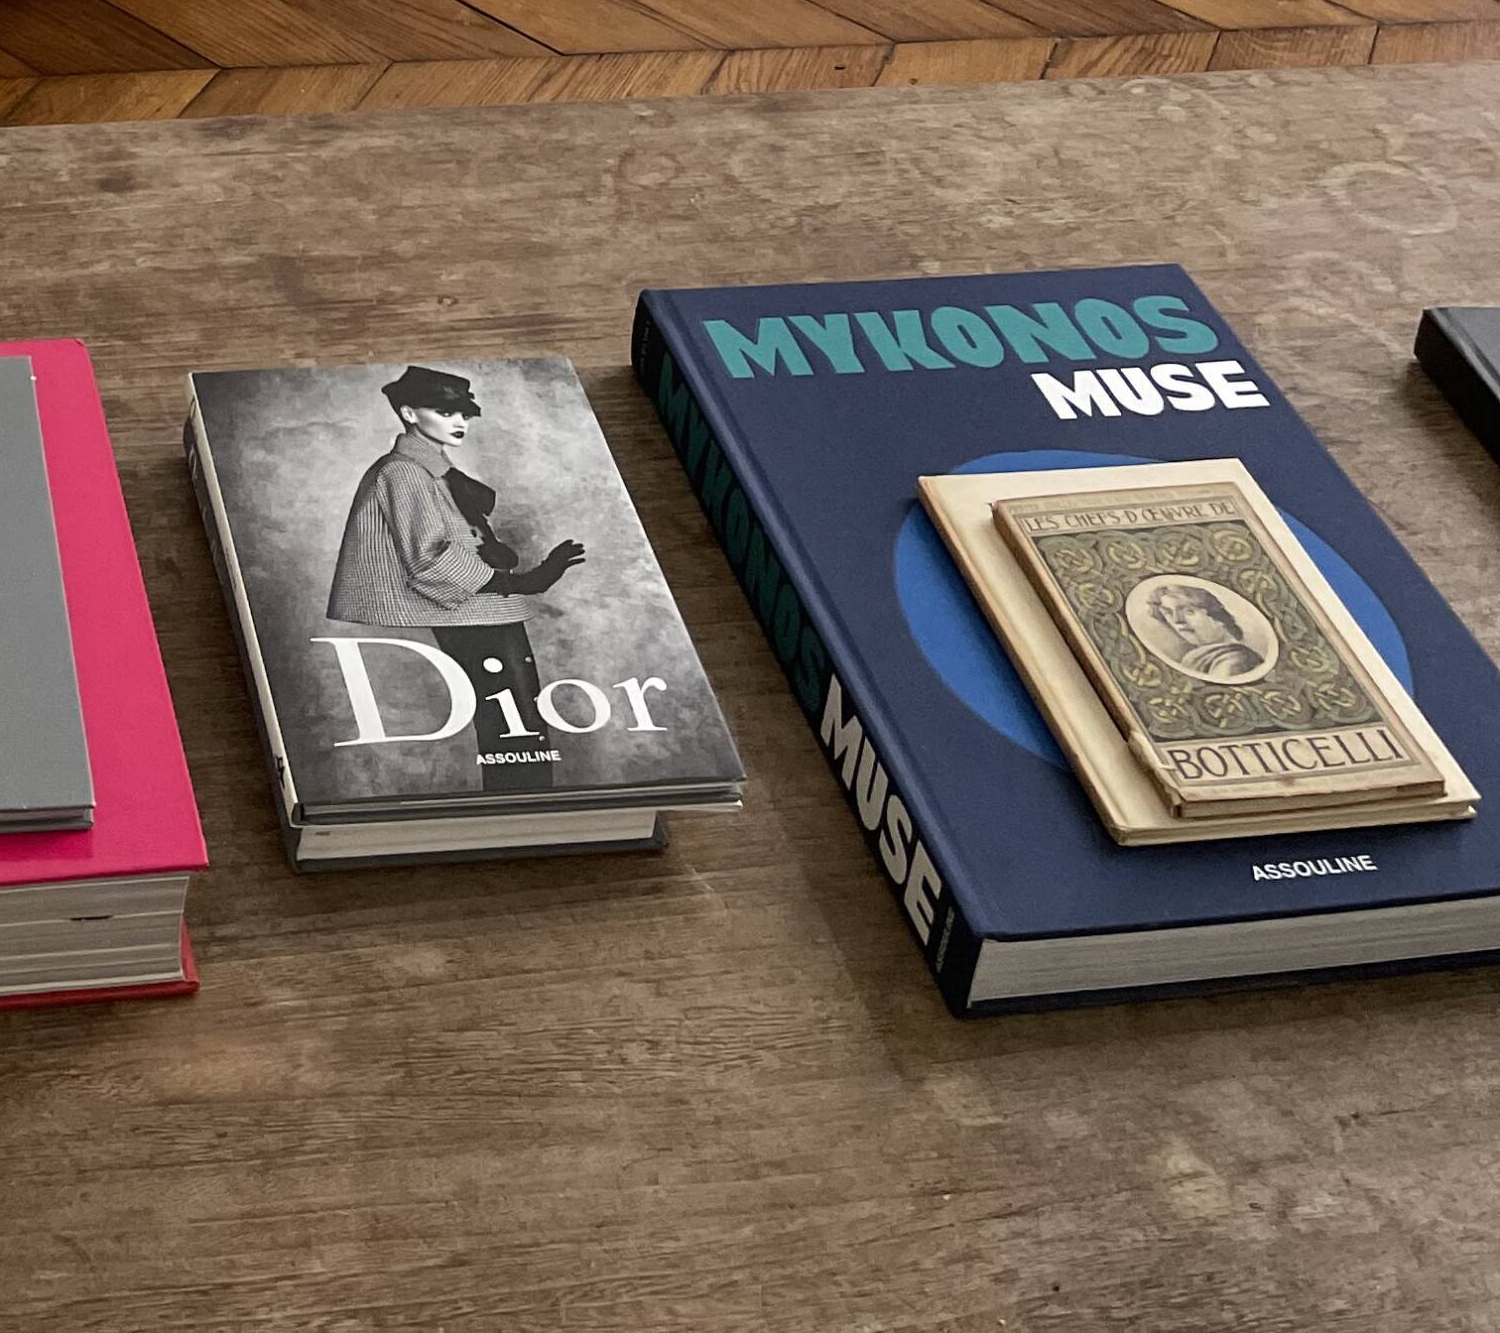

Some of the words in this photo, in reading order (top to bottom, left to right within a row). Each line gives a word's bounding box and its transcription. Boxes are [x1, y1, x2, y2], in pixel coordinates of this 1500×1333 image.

[702, 294, 1219, 379] MYKONOS
[1030, 359, 1271, 420] MUSE
[1023, 515, 1060, 533] LES
[1209, 499, 1236, 517] DE
[309, 637, 668, 747] Dior
[476, 749, 562, 766] ASSOULINE
[1167, 729, 1404, 780] BOTTICELLI
[820, 672, 942, 947] MUSE
[1252, 854, 1378, 882] ASSOULINE
